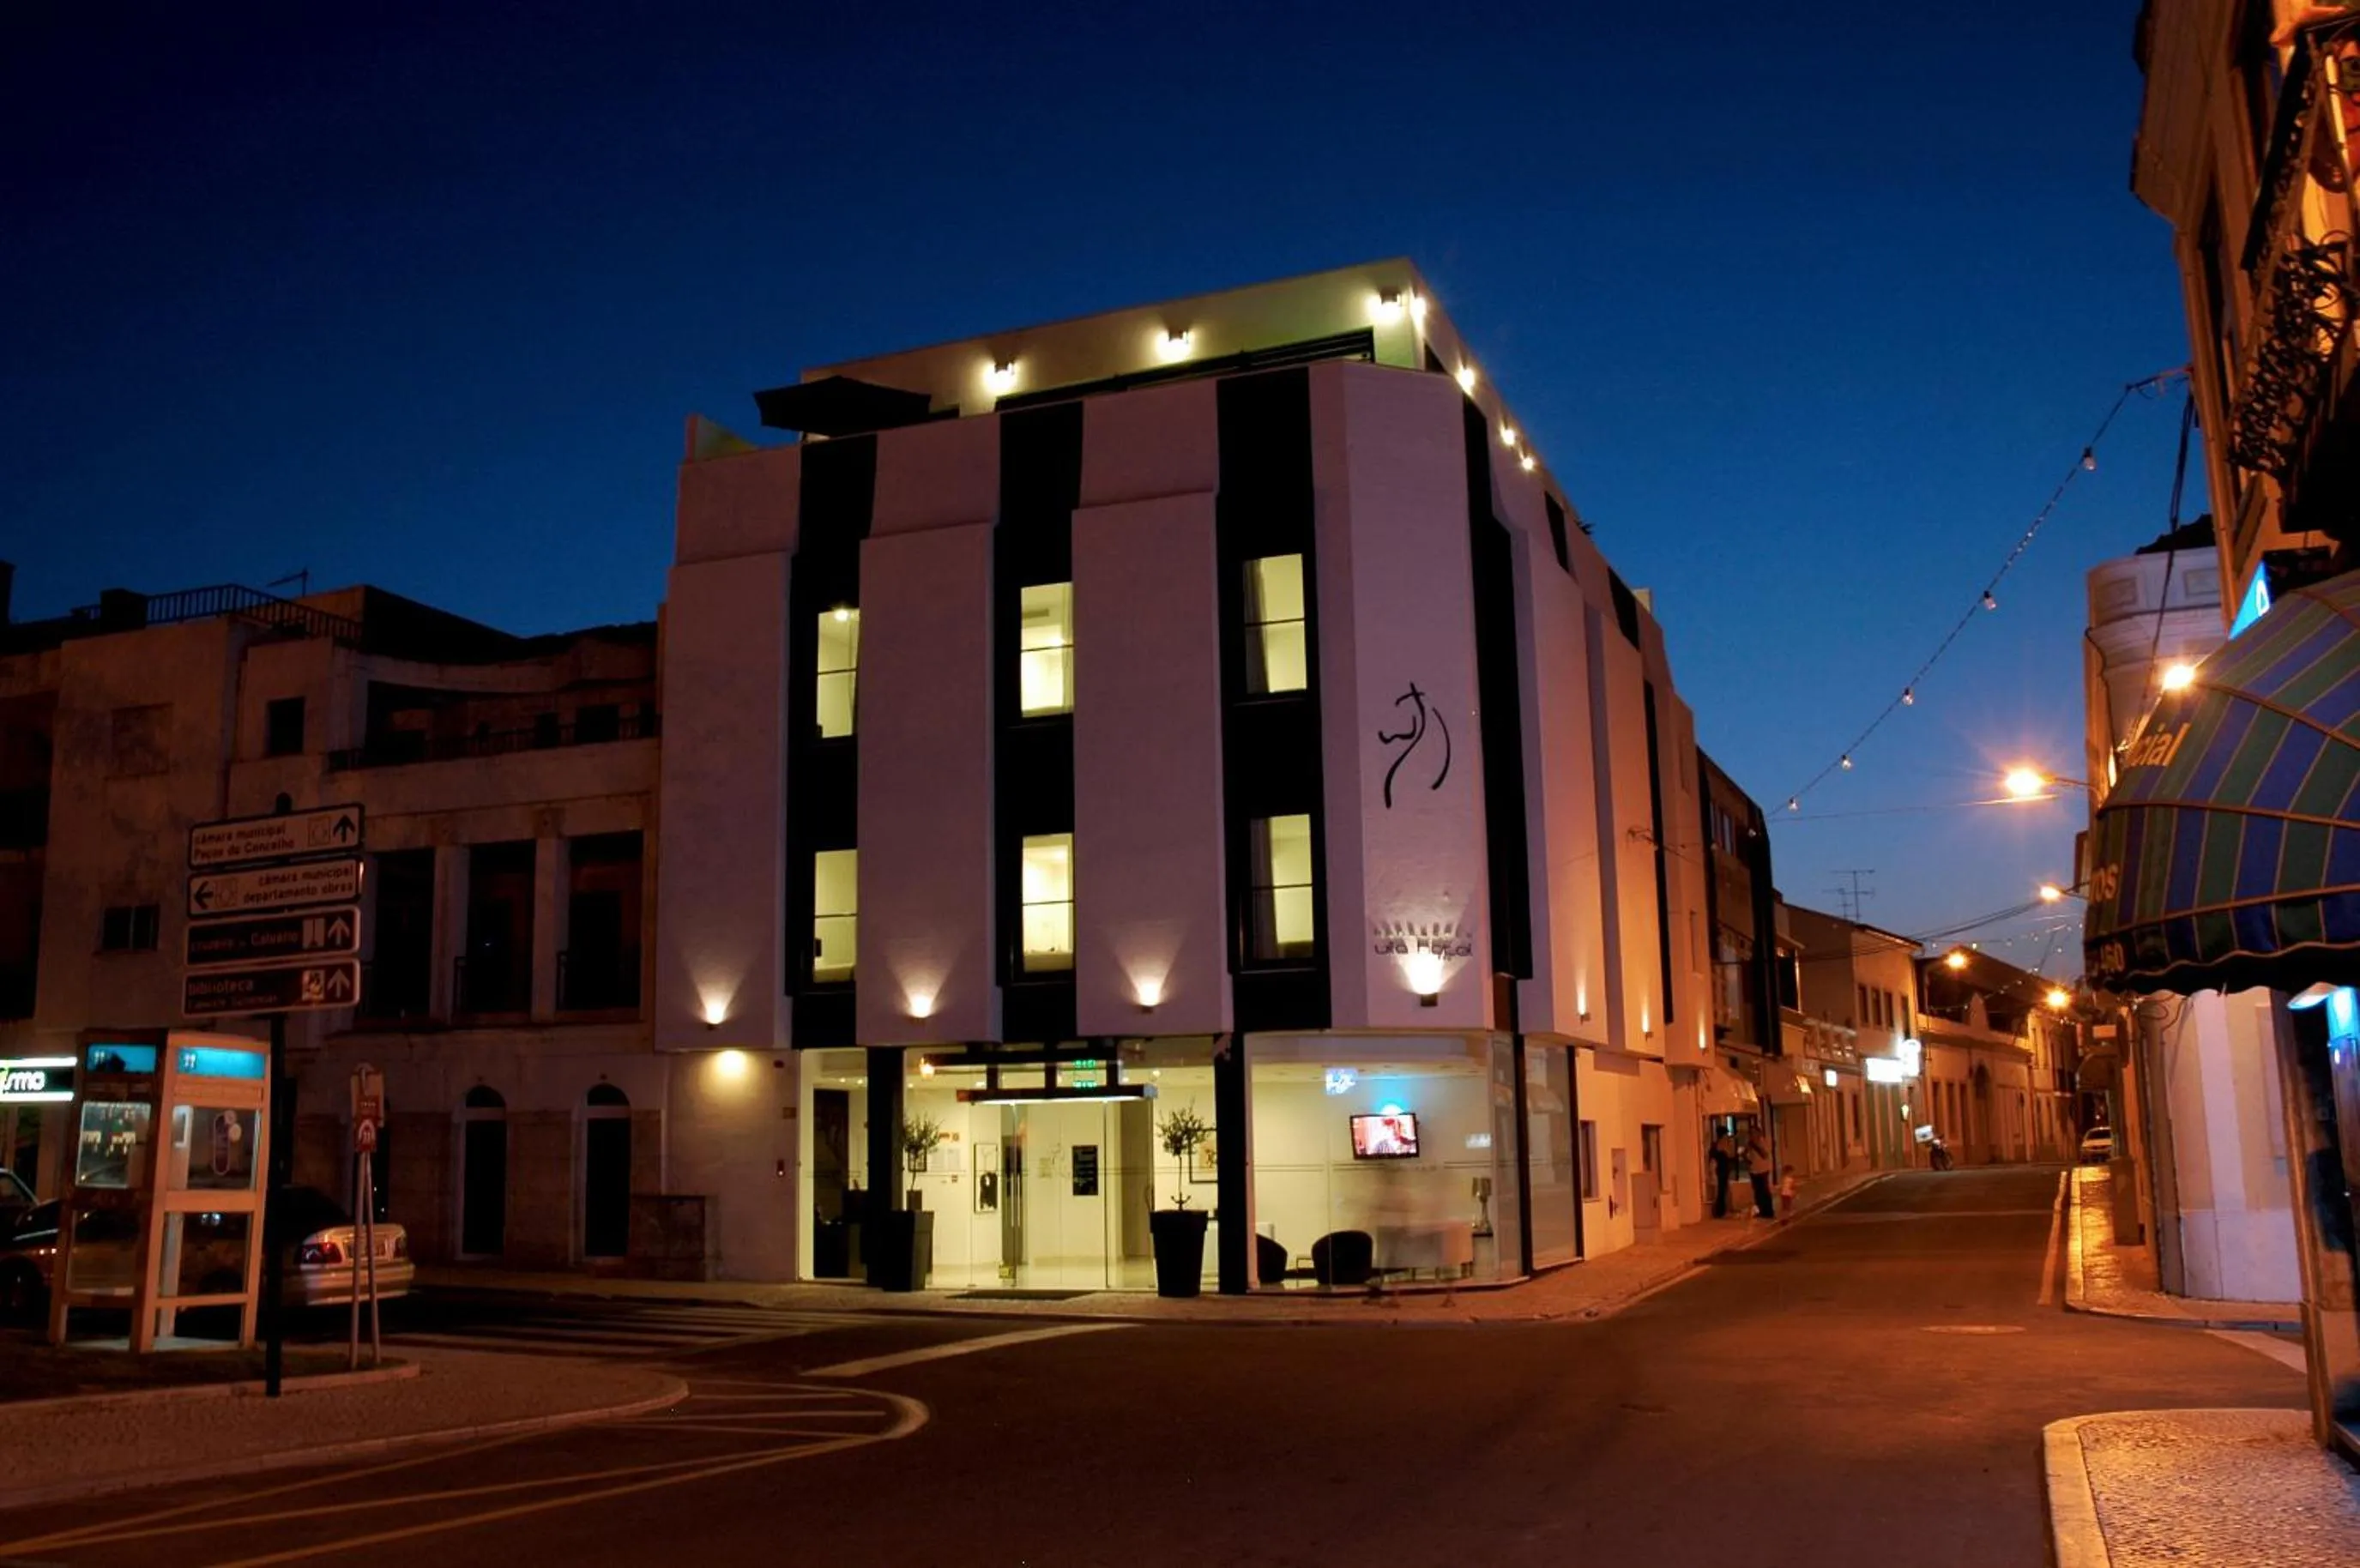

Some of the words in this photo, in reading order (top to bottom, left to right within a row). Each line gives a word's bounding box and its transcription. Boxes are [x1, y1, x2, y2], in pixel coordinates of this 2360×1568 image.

[236, 821, 286, 839] municipal
[244, 838, 295, 854] Concelho
[302, 864, 353, 879] municipal
[243, 884, 318, 904] departamento
